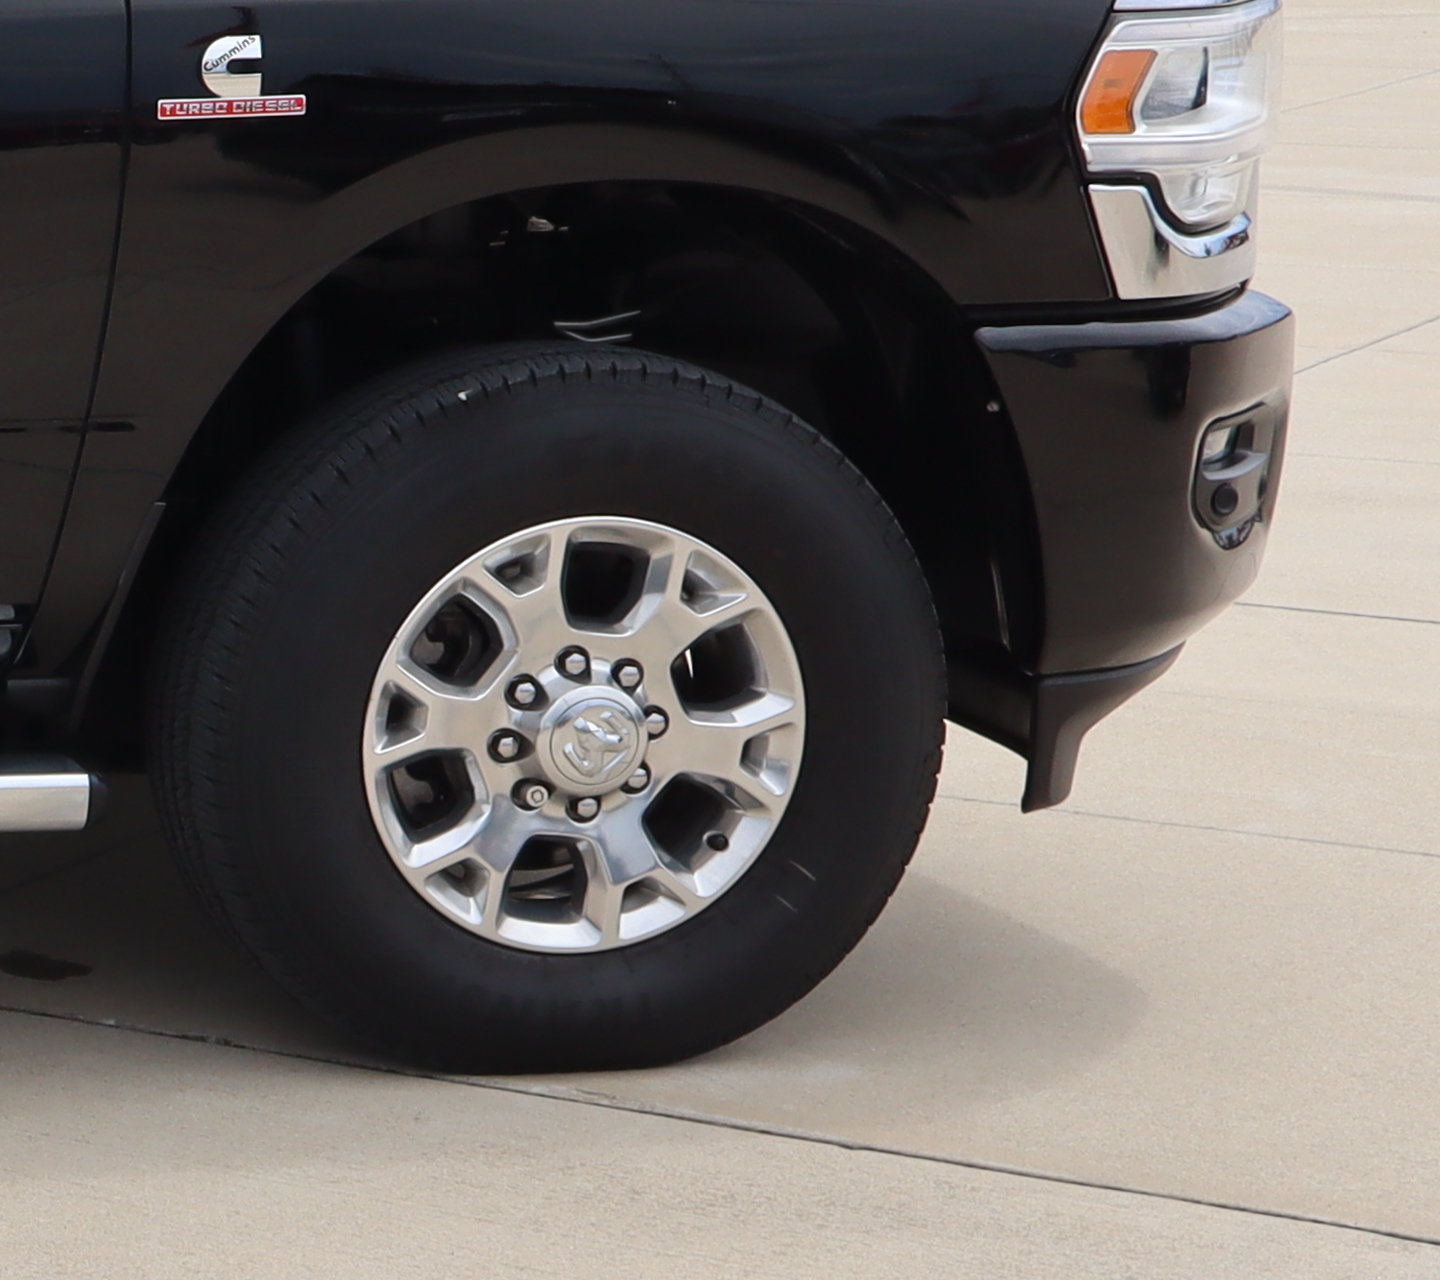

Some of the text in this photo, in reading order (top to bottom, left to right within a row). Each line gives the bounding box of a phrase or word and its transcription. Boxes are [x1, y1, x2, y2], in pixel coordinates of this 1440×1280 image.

[203, 34, 256, 73] Cummins
[161, 99, 303, 117] TURBO DIESEL
